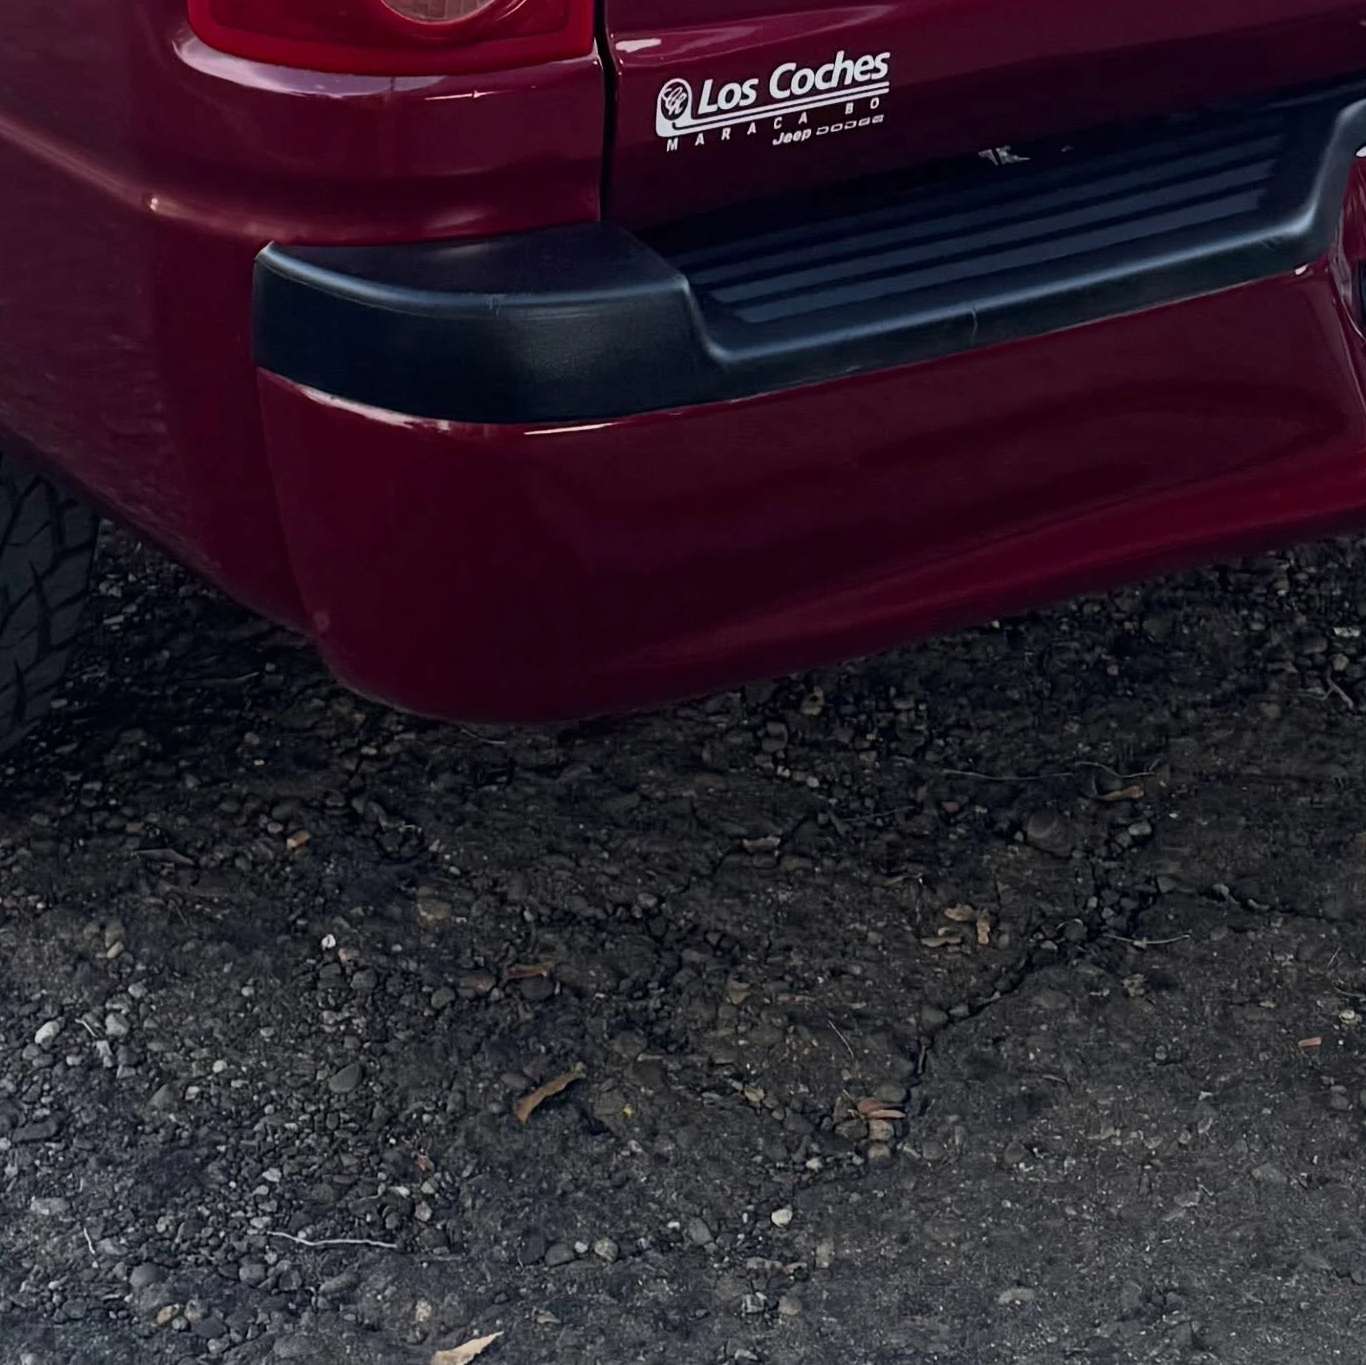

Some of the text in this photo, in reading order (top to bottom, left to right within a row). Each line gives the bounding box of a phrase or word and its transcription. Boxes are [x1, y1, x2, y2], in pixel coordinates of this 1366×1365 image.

[698, 78, 759, 115] Los
[769, 50, 891, 99] Coches
[772, 114, 884, 146] Jeep DODGE
